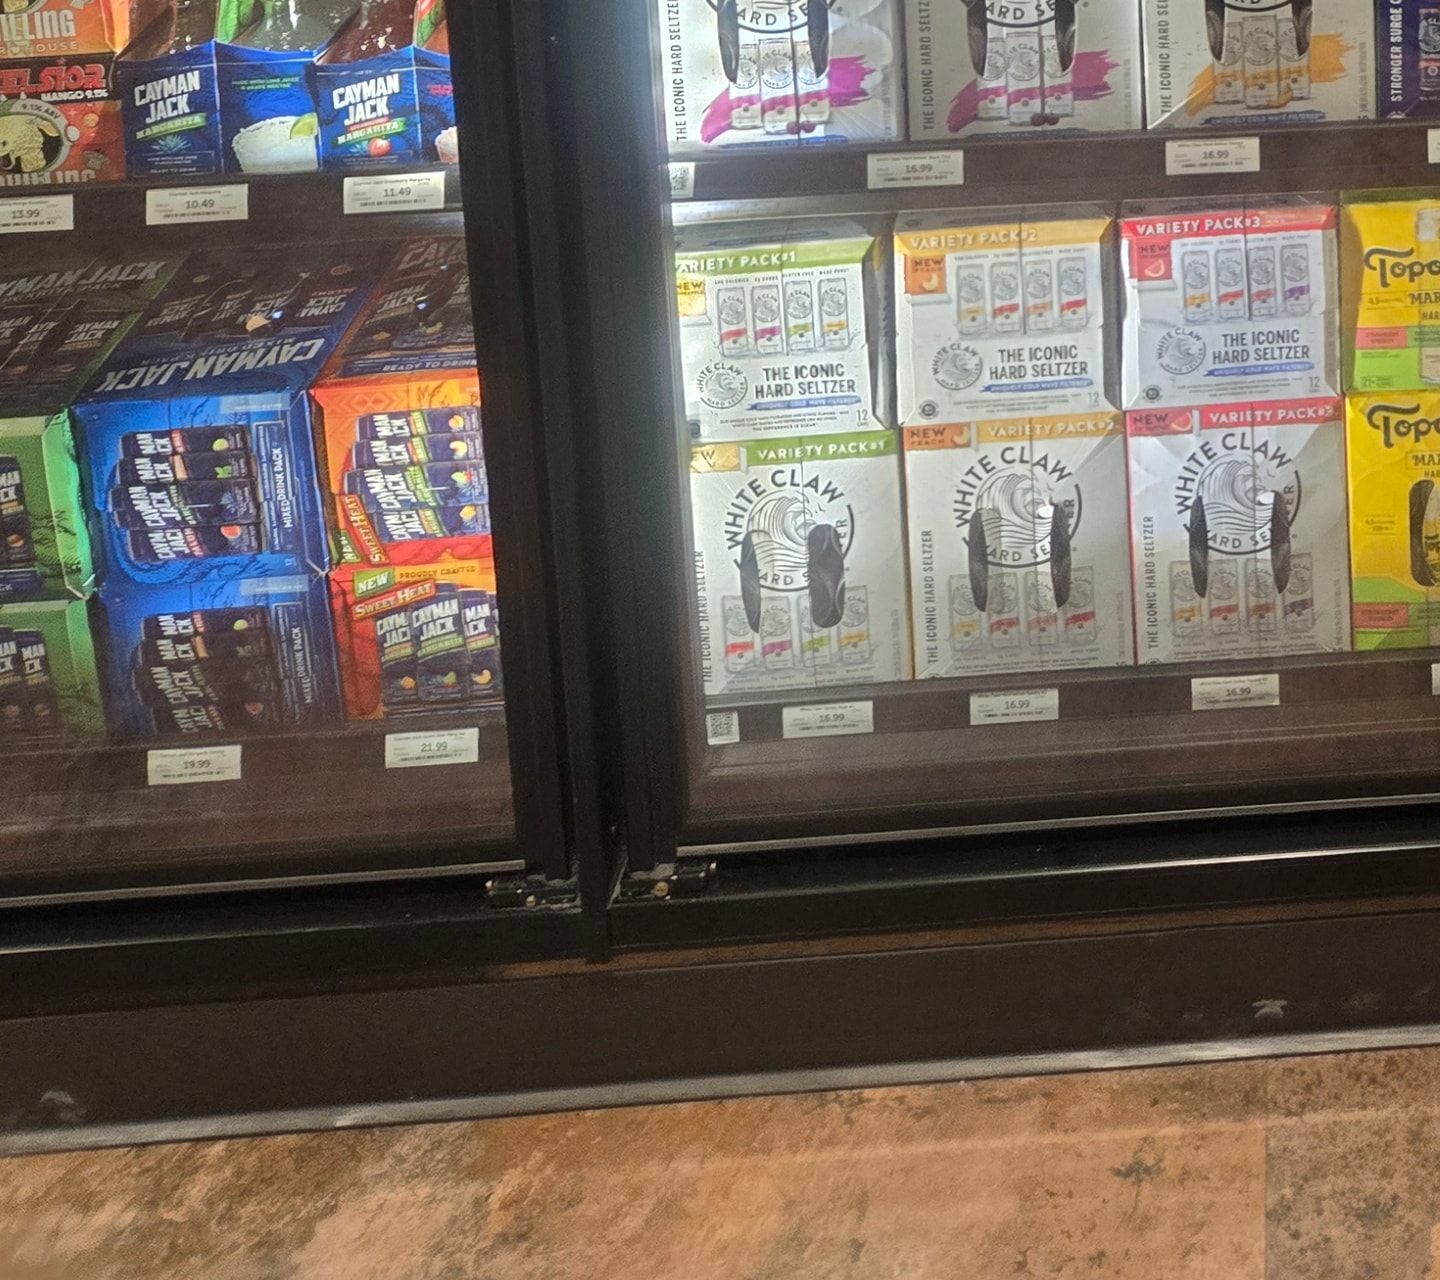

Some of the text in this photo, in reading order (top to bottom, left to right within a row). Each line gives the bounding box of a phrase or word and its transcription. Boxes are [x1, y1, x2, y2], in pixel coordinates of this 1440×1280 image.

[1391, 14, 1402, 49] SURGE
[1390, 49, 1403, 102] STRONGER
[134, 70, 201, 107] CAYMAN
[145, 97, 192, 124] JACK
[382, 186, 412, 199] 11.49
[11, 208, 41, 220] 13.99
[1136, 219, 1200, 235] VARIETY
[1222, 329, 1300, 347] THE ICONIC
[97, 338, 326, 393] CAYMAN JACK
[1212, 345, 1310, 365] HARD SELTZER
[358, 573, 390, 593] NEW
[397, 583, 433, 604] HEAT
[412, 598, 459, 628] CAYMAN
[419, 614, 455, 641] JACK
[420, 741, 448, 754] 21.99
